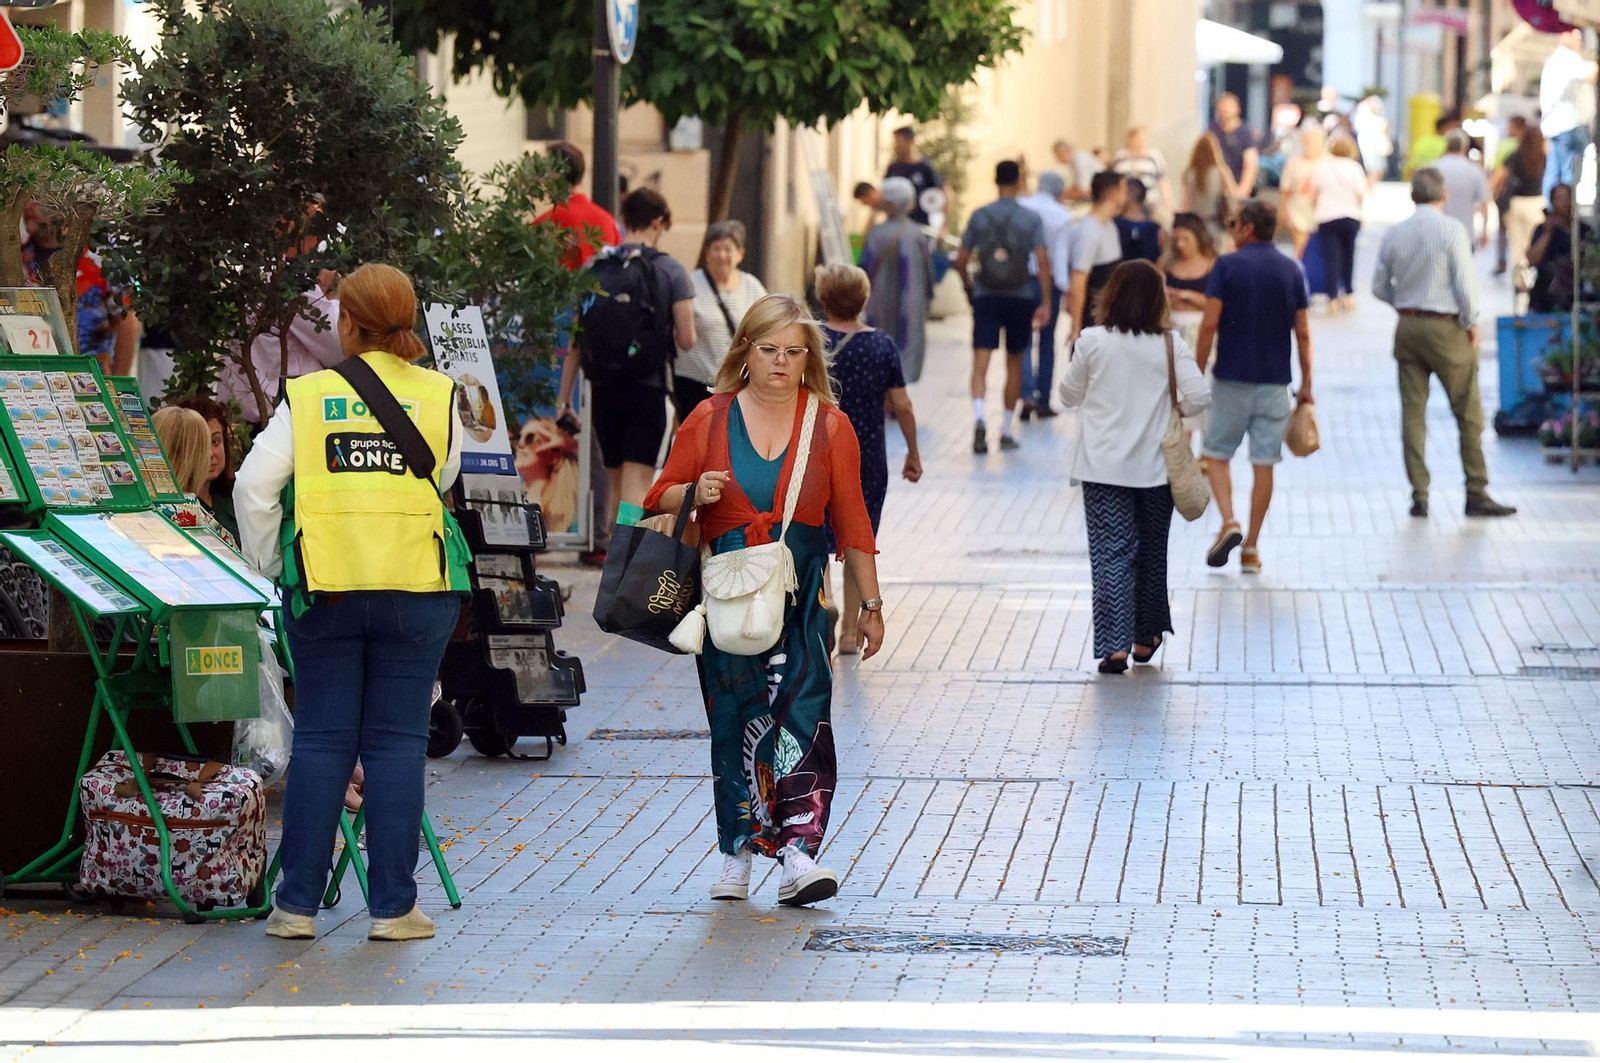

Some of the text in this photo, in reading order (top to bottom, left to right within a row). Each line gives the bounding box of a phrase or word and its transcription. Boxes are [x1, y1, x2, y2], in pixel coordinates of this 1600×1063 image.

[28, 329, 51, 349] 27
[448, 350, 479, 363] GRATIS
[350, 439, 380, 450] grupo
[350, 450, 404, 470] ONCE
[203, 651, 239, 669] ONCE
